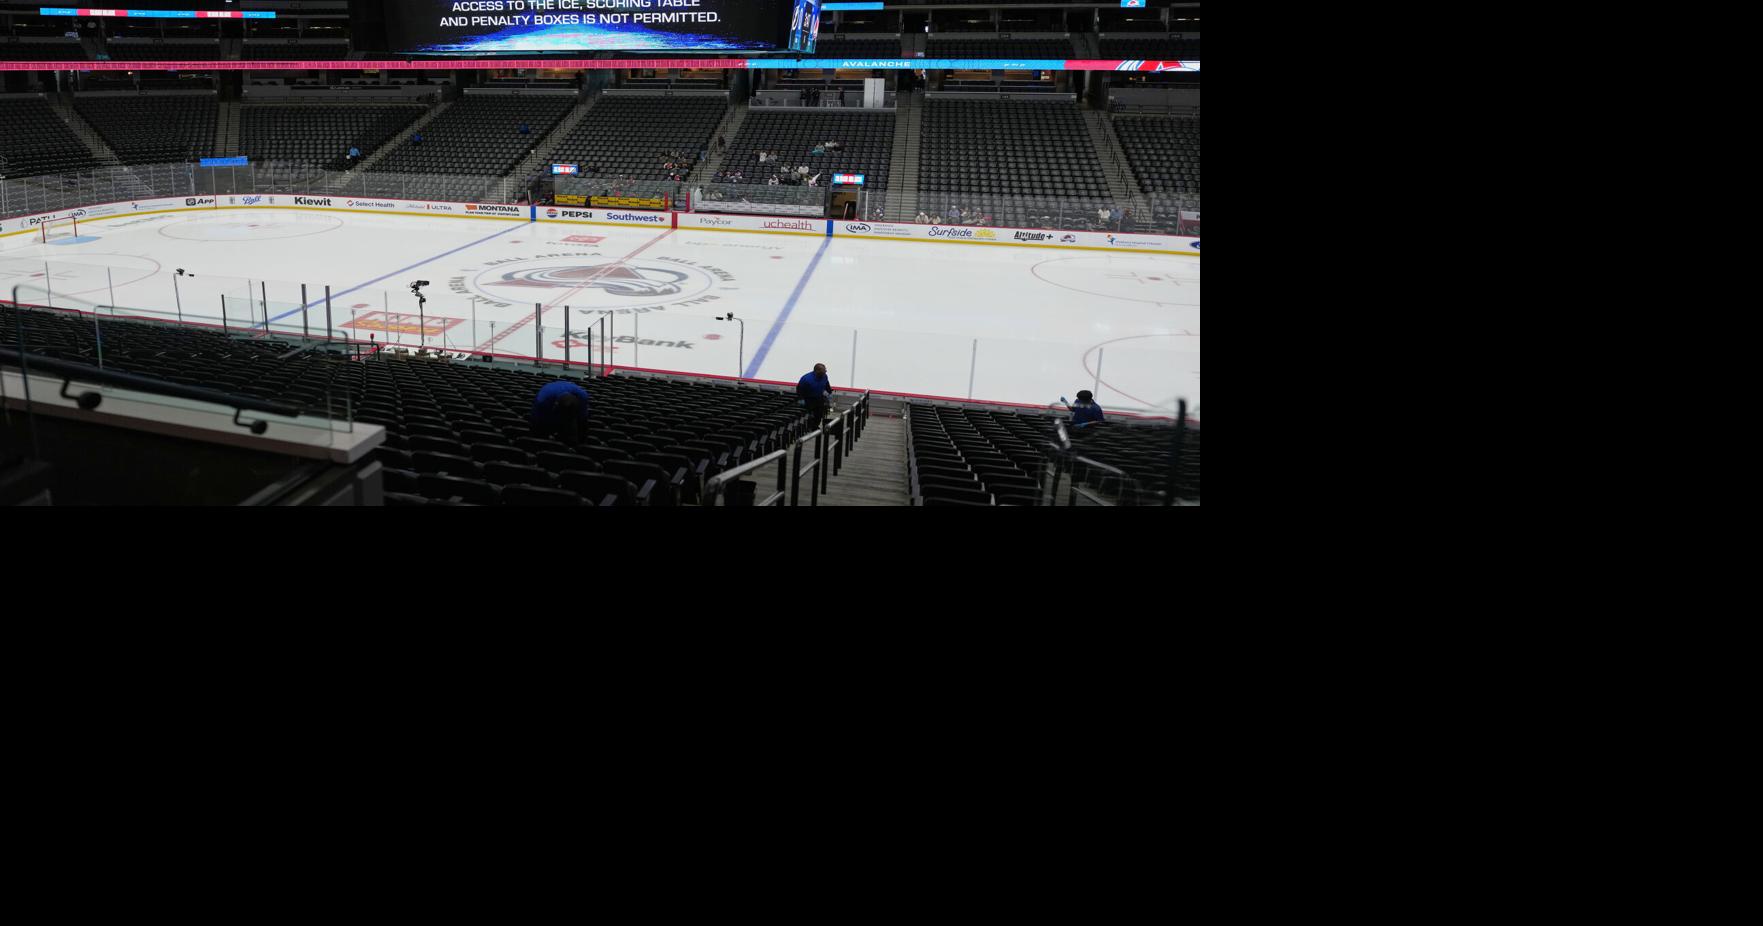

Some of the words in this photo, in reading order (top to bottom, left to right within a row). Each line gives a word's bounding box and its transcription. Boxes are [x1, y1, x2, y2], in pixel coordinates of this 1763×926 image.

[452, 1, 504, 12] ACCESS
[506, 0, 525, 11] TO
[527, 0, 555, 10] THE
[558, 0, 583, 10] ICE,
[586, 0, 651, 9] SCORING
[439, 16, 468, 27] AND
[471, 15, 531, 26] PENALTY
[534, 14, 580, 25] BOXES
[583, 14, 596, 24] IS
[599, 13, 630, 24] NOT
[633, 11, 721, 23] PERMITTED.
[294, 196, 332, 207] Kiewit
[355, 200, 374, 208] Select
[375, 201, 395, 209] Health
[478, 204, 520, 212] MONTANA
[561, 210, 593, 219] PEPSI
[606, 212, 658, 223] Southwest
[700, 217, 733, 226] Paycor
[763, 219, 812, 230] uchealth
[928, 226, 972, 237] Surfside
